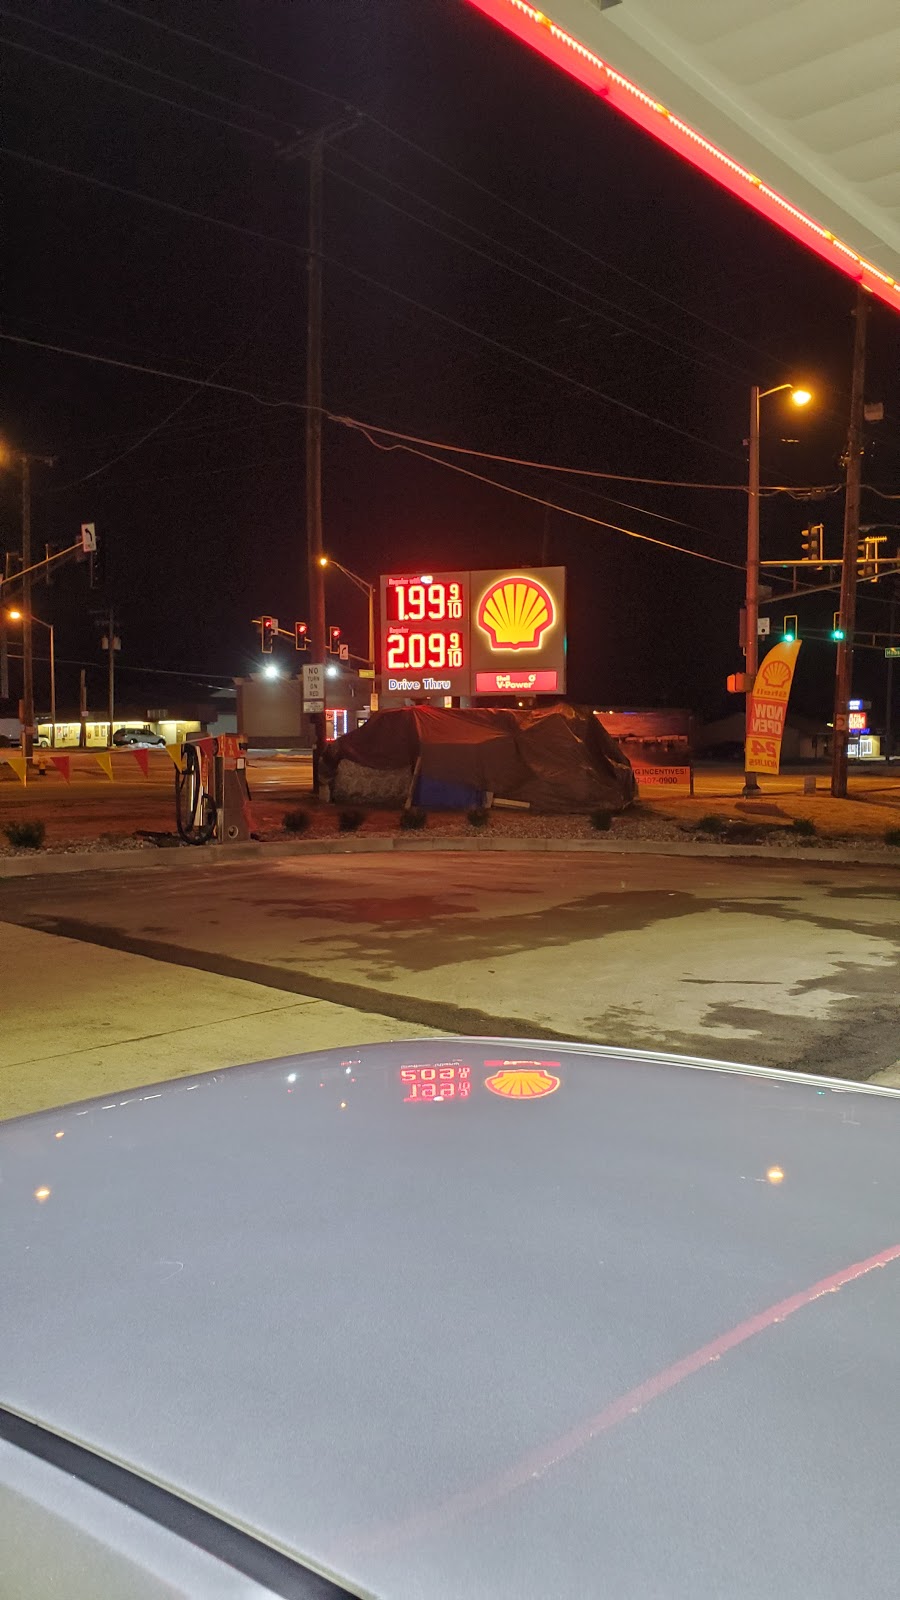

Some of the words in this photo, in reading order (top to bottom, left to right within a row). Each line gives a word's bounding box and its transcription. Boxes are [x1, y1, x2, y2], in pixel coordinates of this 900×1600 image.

[395, 584, 445, 620] 1.99
[387, 633, 445, 669] 2.09
[308, 667, 319, 675] NO
[388, 679, 420, 690] Drive
[422, 678, 451, 690] Thru
